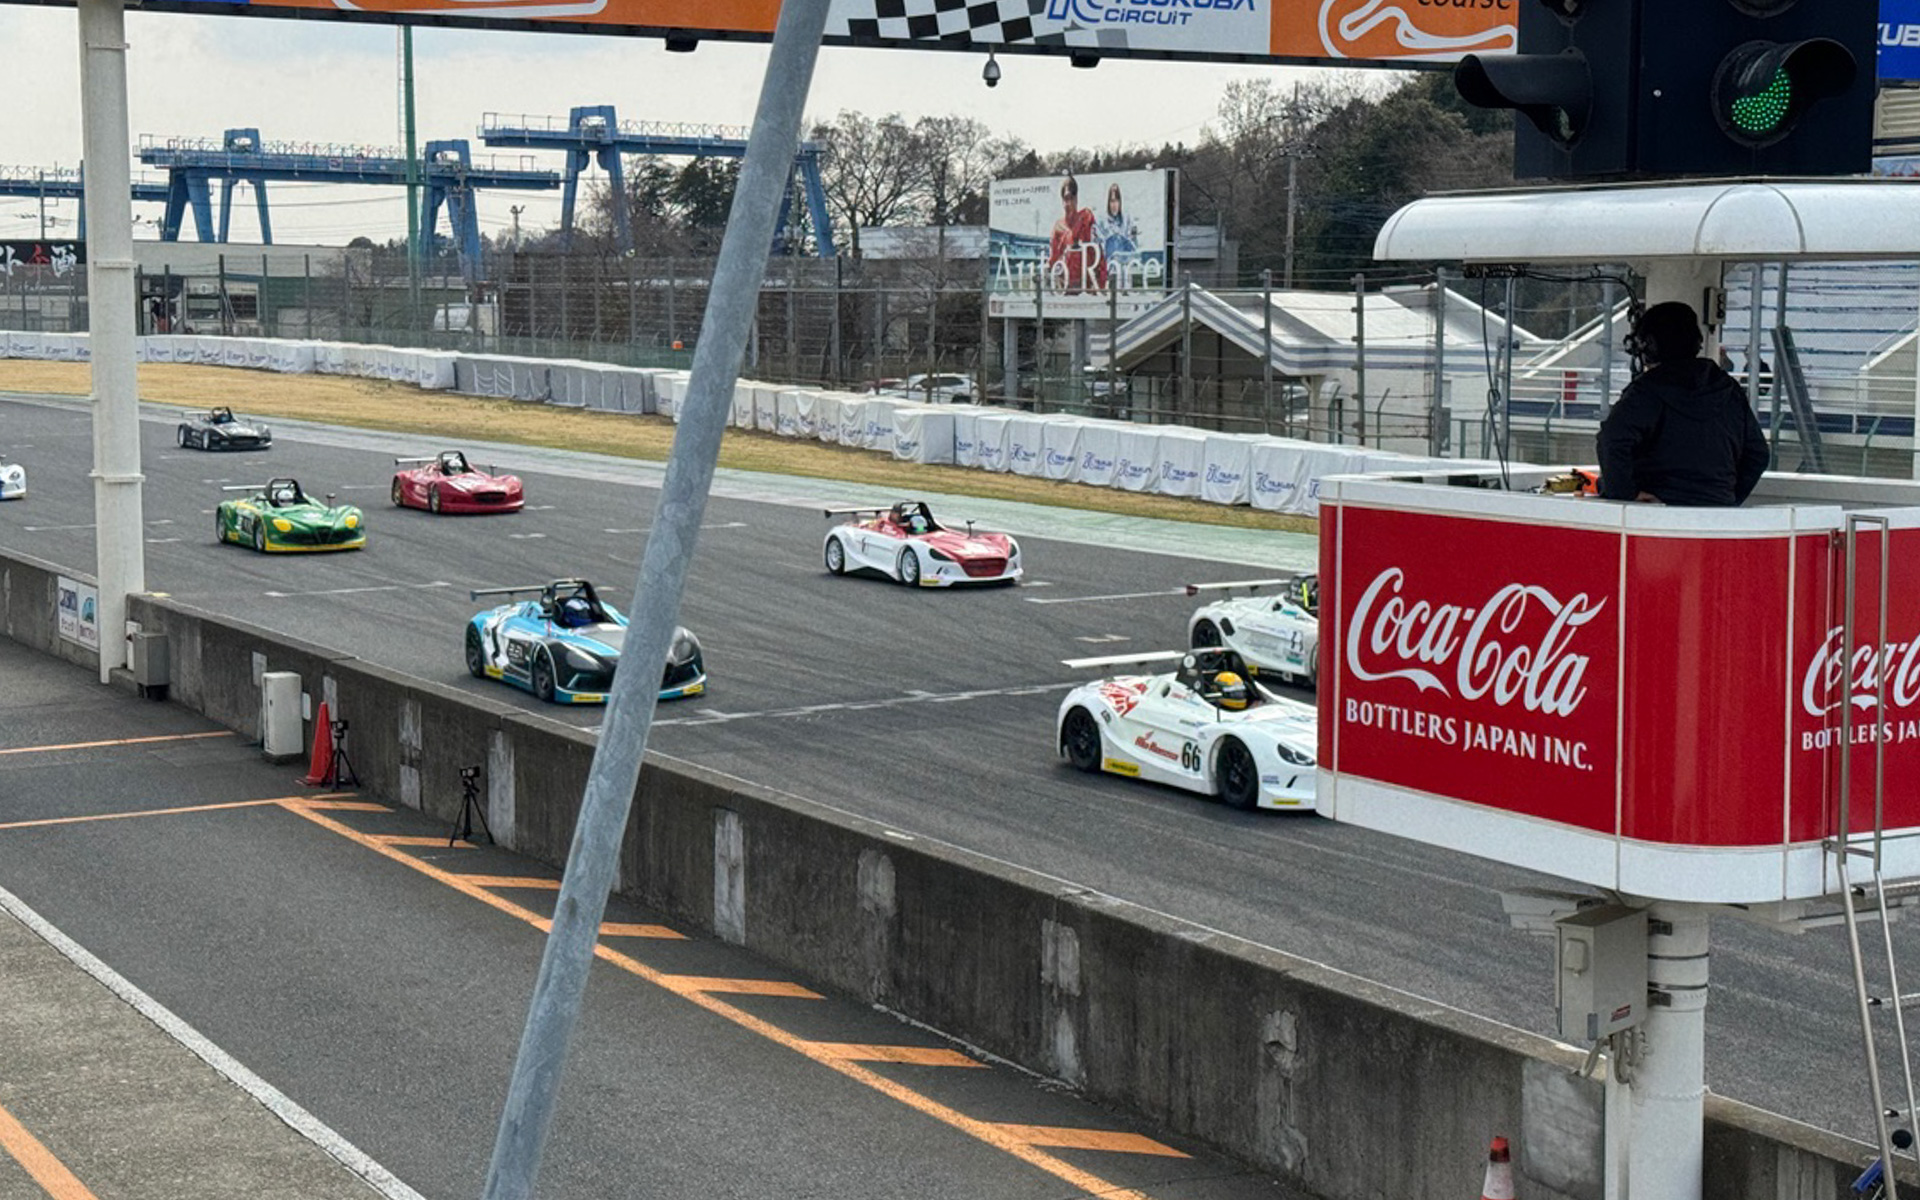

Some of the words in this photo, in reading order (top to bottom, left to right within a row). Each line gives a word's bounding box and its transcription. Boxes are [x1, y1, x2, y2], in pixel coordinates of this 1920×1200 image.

[993, 242, 1070, 295] Auto
[1346, 566, 1609, 718] Coca-Cola
[1181, 741, 1202, 773] 66
[1345, 697, 1458, 746] BOTTLERS
[1462, 720, 1538, 761] JAPAN
[1543, 735, 1594, 773] INC.
[1897, 719, 1920, 744] JA
